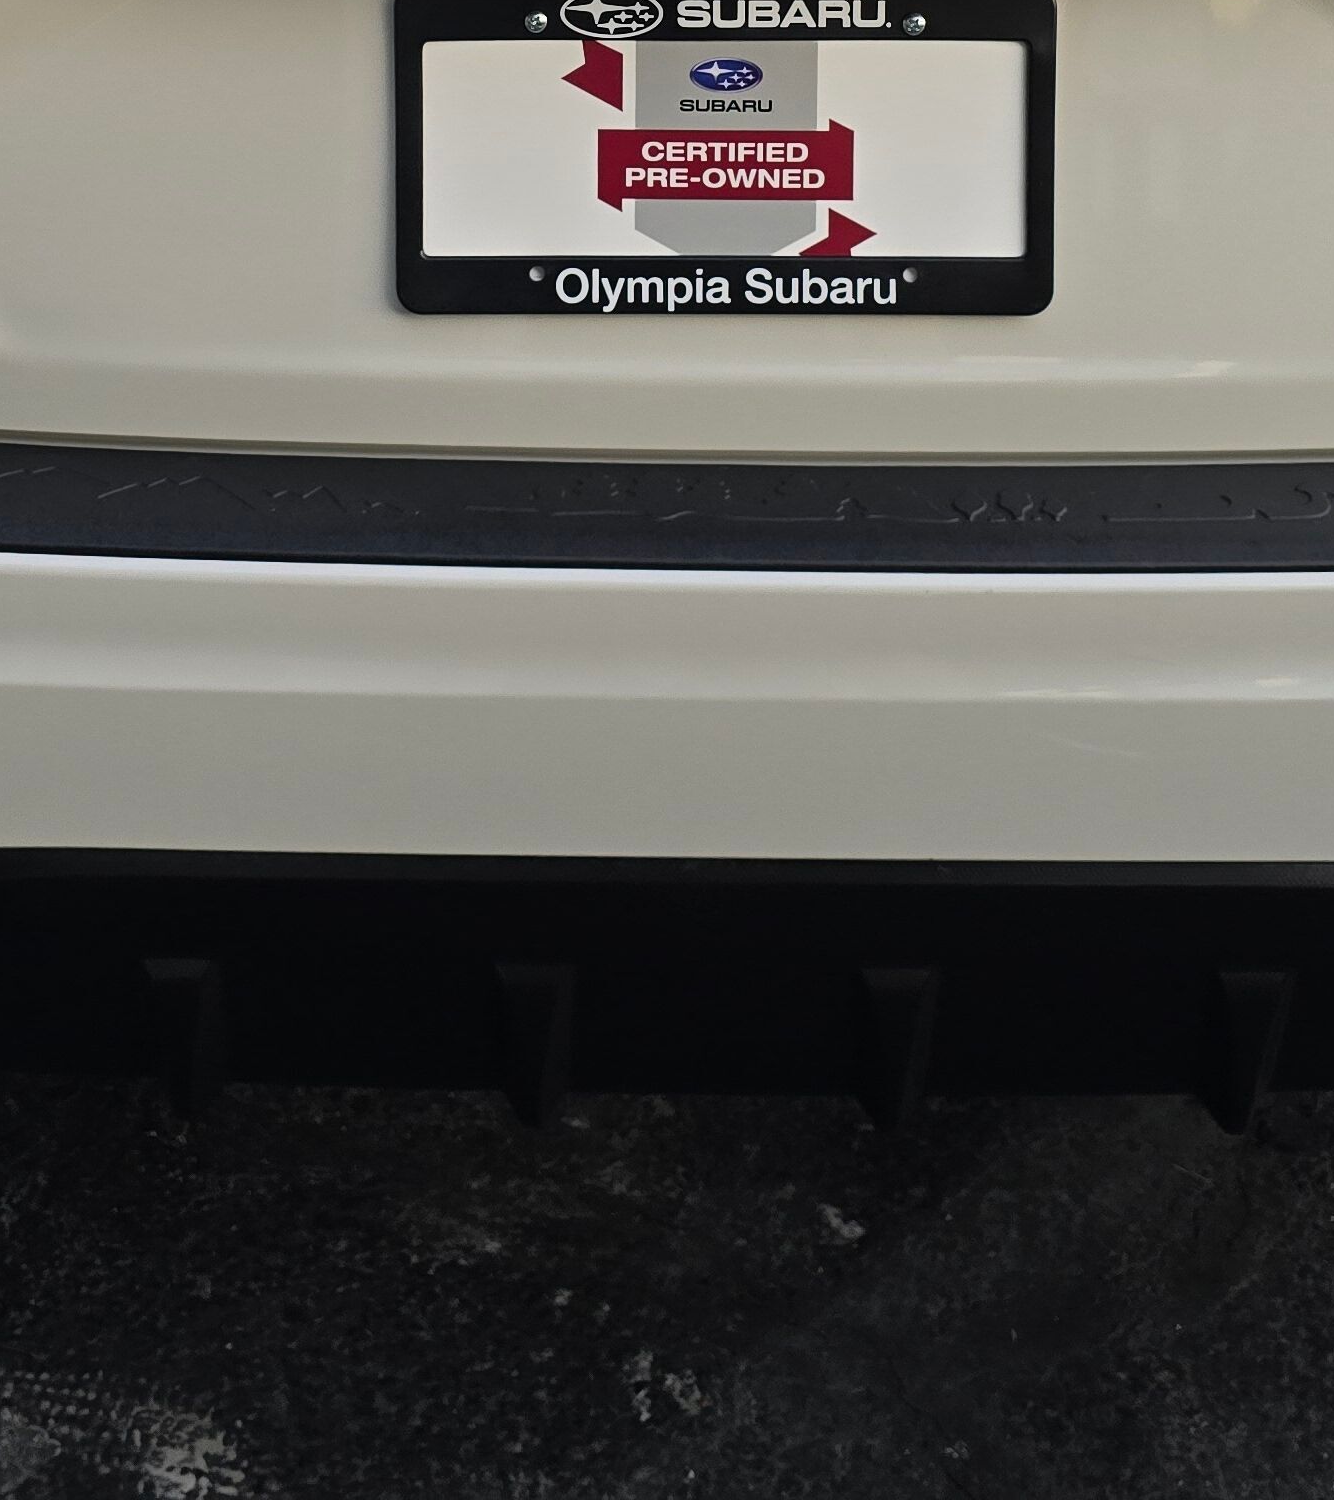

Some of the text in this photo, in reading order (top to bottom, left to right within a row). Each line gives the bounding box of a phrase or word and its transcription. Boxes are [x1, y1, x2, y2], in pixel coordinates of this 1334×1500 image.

[679, 99, 773, 113] SUBARU
[641, 141, 809, 163] CERTIFIED
[625, 167, 826, 189] PRE-OWNED
[555, 267, 898, 312] Olympia Subaru
